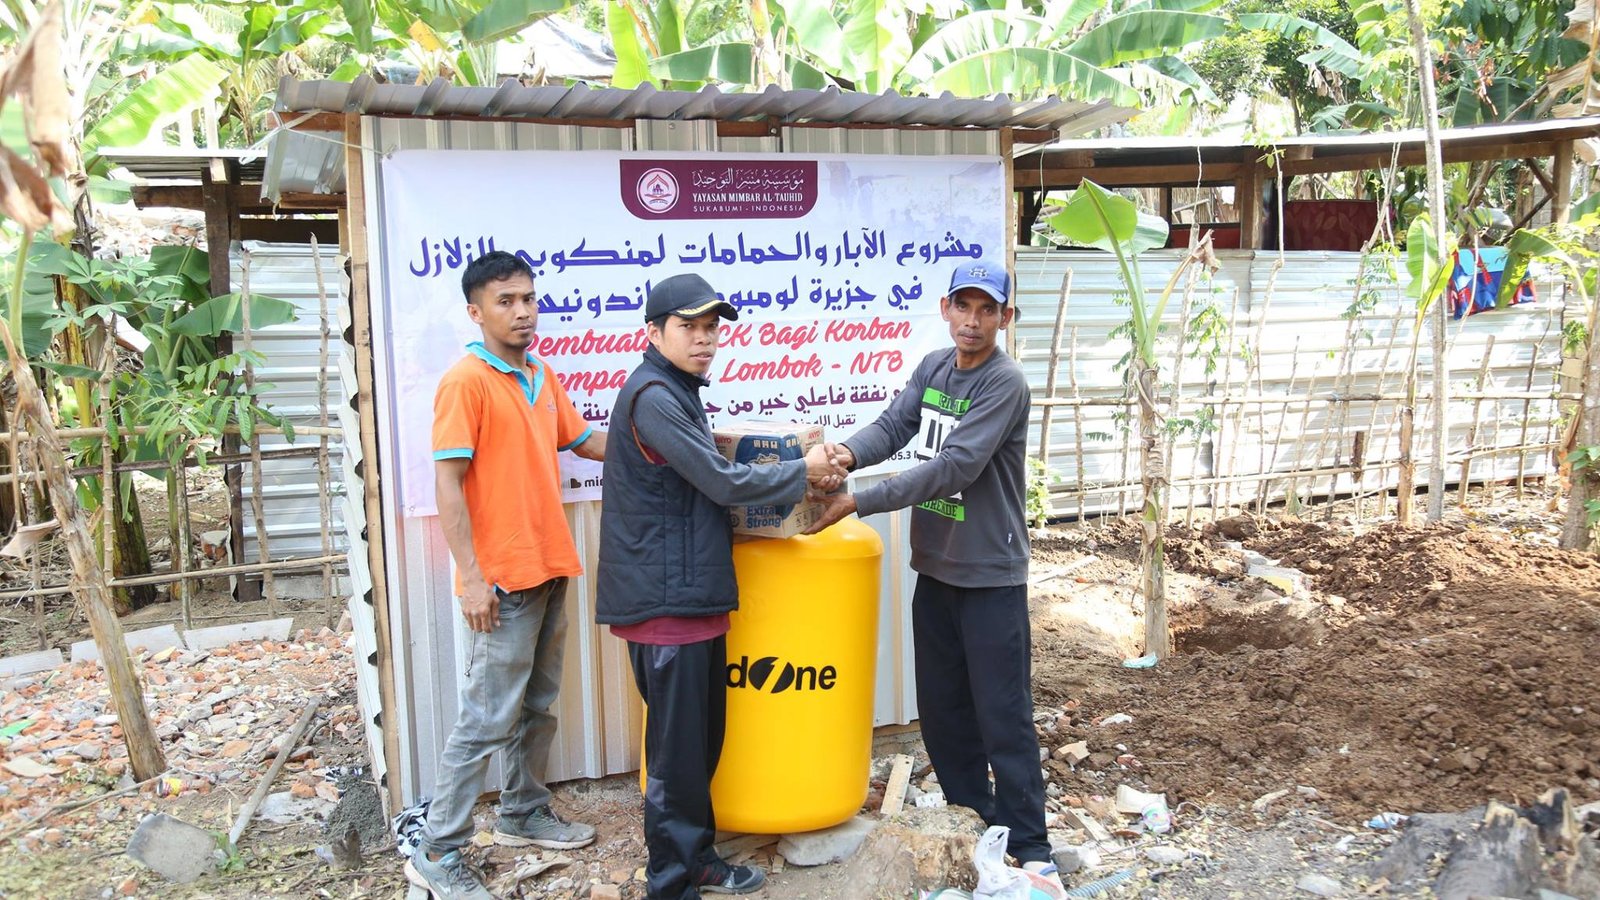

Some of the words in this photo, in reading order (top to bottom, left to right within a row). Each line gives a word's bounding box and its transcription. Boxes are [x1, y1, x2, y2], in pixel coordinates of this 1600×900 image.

[692, 193, 727, 203] YAYASAN
[728, 193, 761, 202] MIMBAR
[678, 230, 828, 266] والحمامات
[896, 231, 984, 266] مشروع
[716, 275, 799, 314] لومبو
[808, 278, 877, 311] جزيرة
[887, 275, 922, 311] في
[718, 323, 753, 348] CK
[758, 320, 819, 350] Bagi
[824, 316, 912, 343] Korban
[719, 353, 823, 383] Lombok
[850, 350, 904, 375] NTB
[758, 393, 790, 416] خير
[850, 384, 887, 404] نفقة
[728, 399, 754, 416] من
[833, 413, 856, 429] تقبل
[887, 450, 911, 461] 05.3
[746, 505, 776, 516] Extra
[746, 516, 781, 529] Strong
